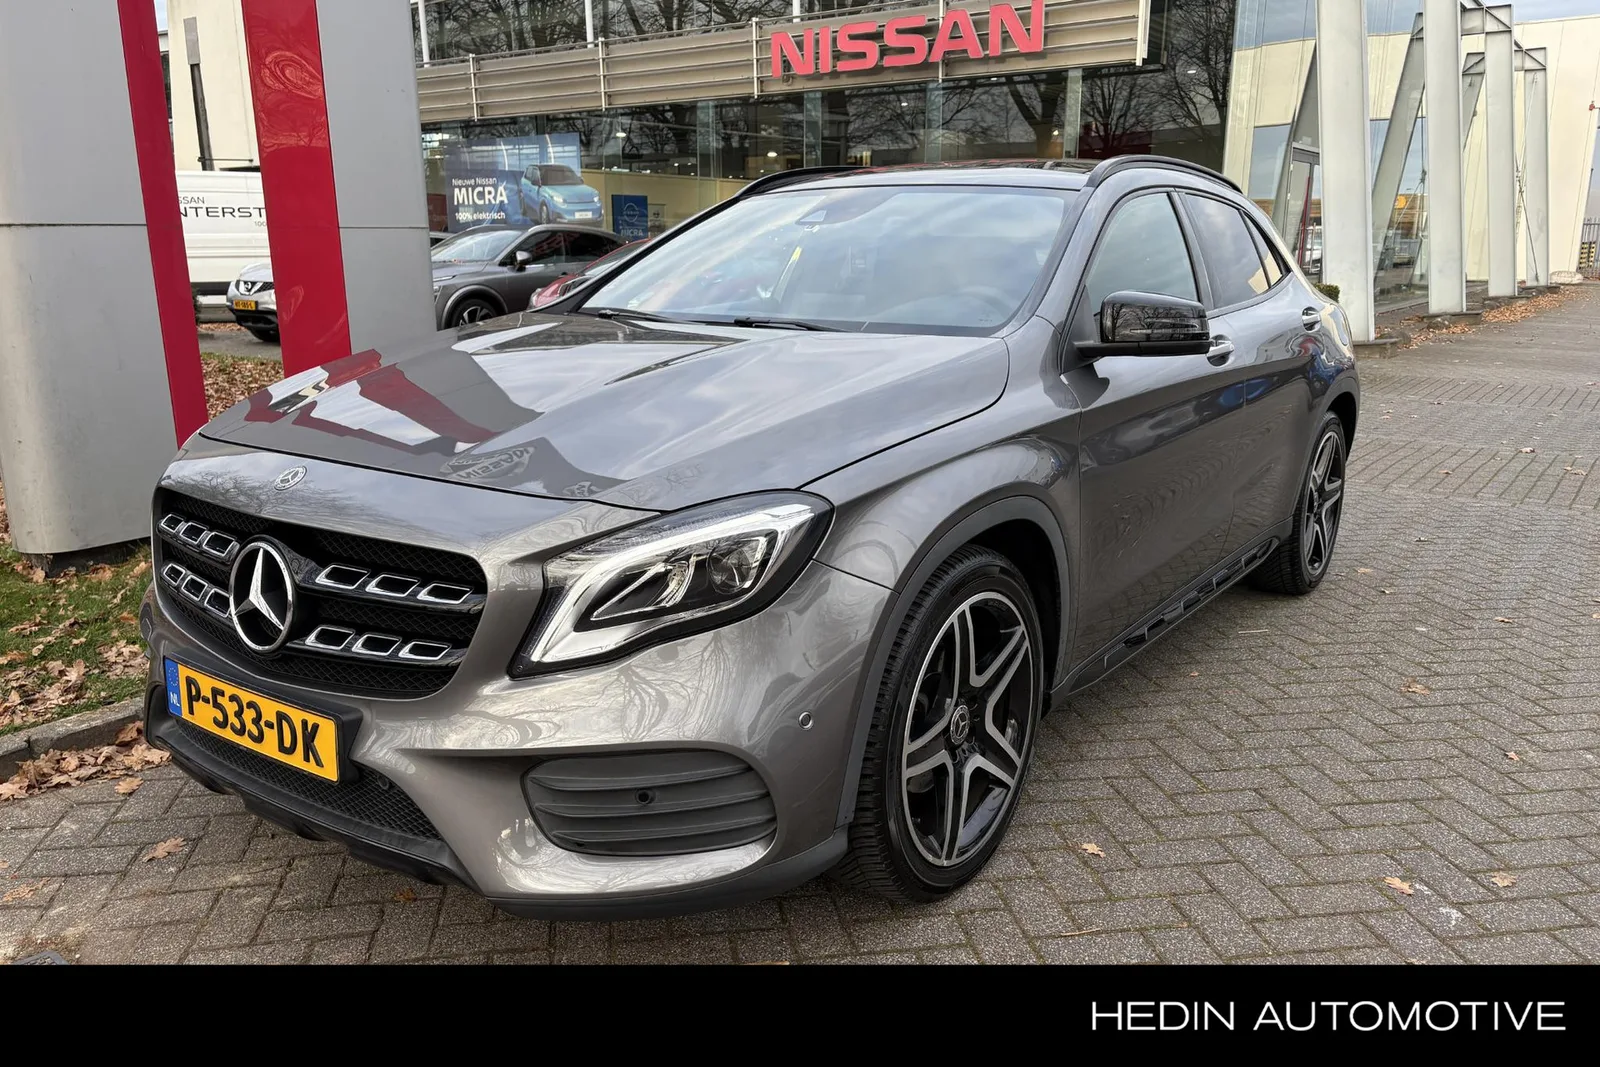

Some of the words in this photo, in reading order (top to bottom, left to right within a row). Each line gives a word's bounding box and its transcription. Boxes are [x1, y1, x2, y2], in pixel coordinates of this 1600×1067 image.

[771, 0, 1045, 79] NISSAN
[452, 178, 475, 186] Nieuwe
[476, 177, 498, 185] Nissan
[453, 186, 508, 206] MICRA
[455, 212, 473, 221] 100%
[473, 210, 506, 220] elektrisch
[169, 691, 180, 707] NL
[185, 675, 324, 768] P-533-DK
